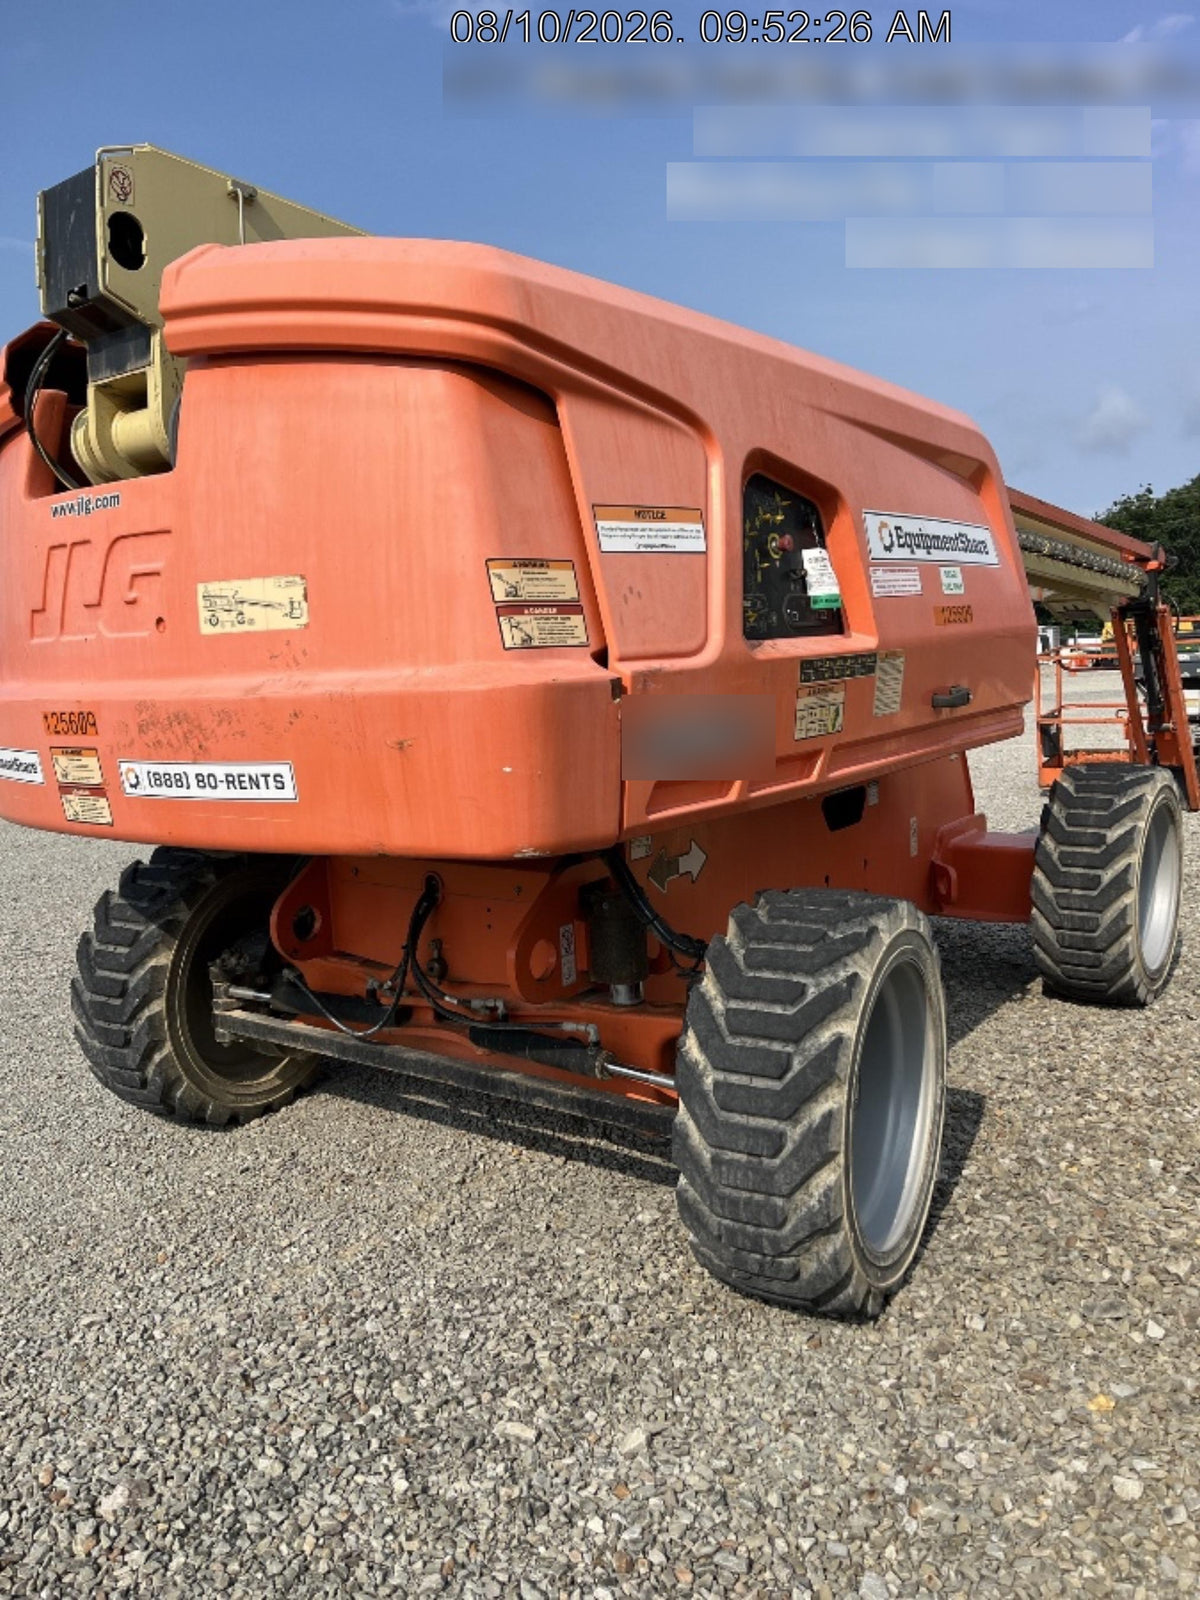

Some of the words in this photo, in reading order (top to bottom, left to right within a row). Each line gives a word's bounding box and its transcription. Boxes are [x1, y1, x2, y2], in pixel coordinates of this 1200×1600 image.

[51, 493, 120, 517] www.jlg.com
[894, 525, 989, 556] EquipmentShare
[30, 529, 172, 644] JLG
[147, 770, 191, 789] (888)
